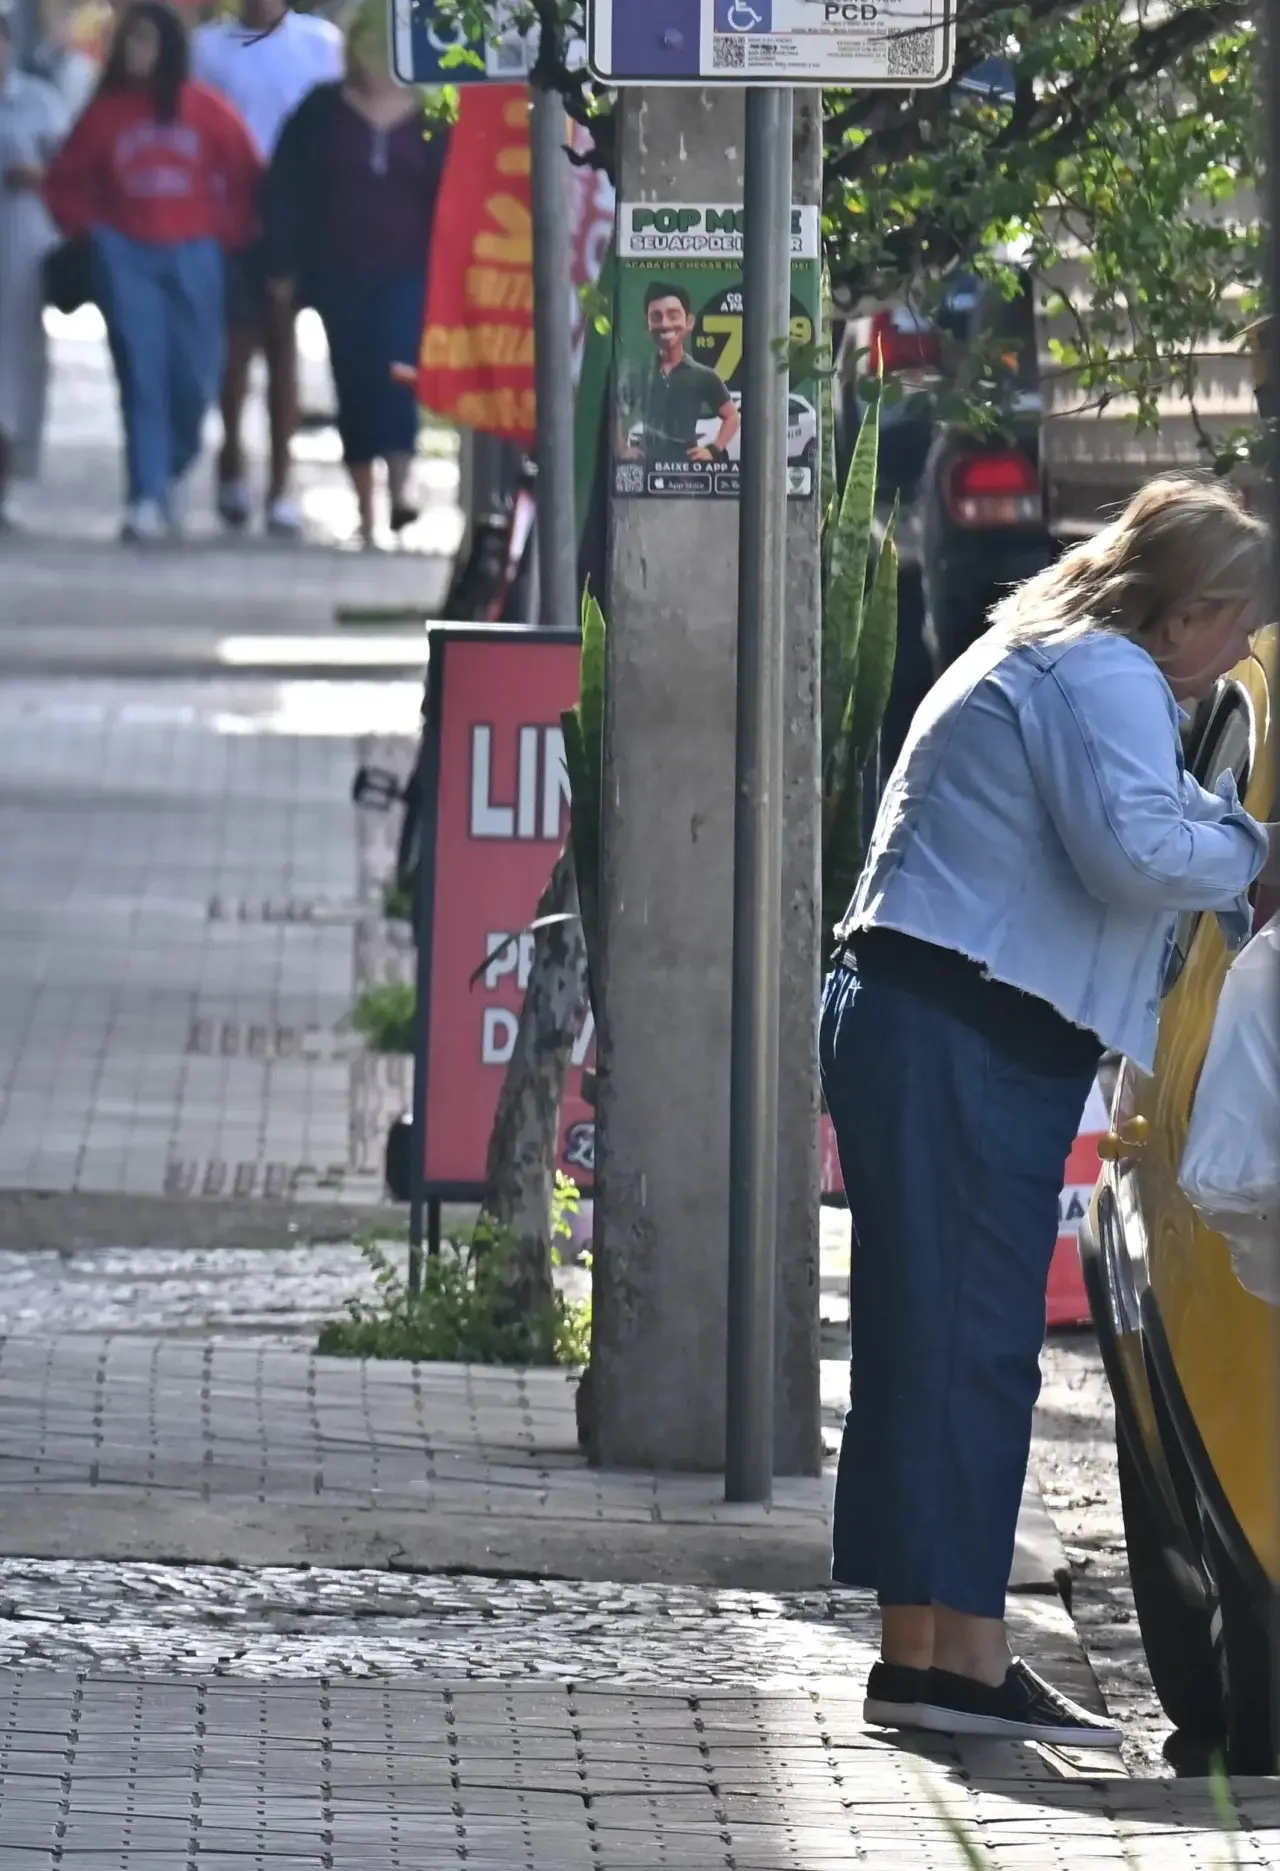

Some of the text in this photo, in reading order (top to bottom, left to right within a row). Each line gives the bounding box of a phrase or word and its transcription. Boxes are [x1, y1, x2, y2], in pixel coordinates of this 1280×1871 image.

[824, 4, 878, 20] PCD
[632, 208, 701, 233] POP
[630, 235, 669, 251] SEU
[670, 235, 708, 250] APP
[709, 235, 734, 251] DE
[655, 462, 689, 472] BAIXE
[693, 462, 702, 472] O
[705, 462, 728, 473] APP
